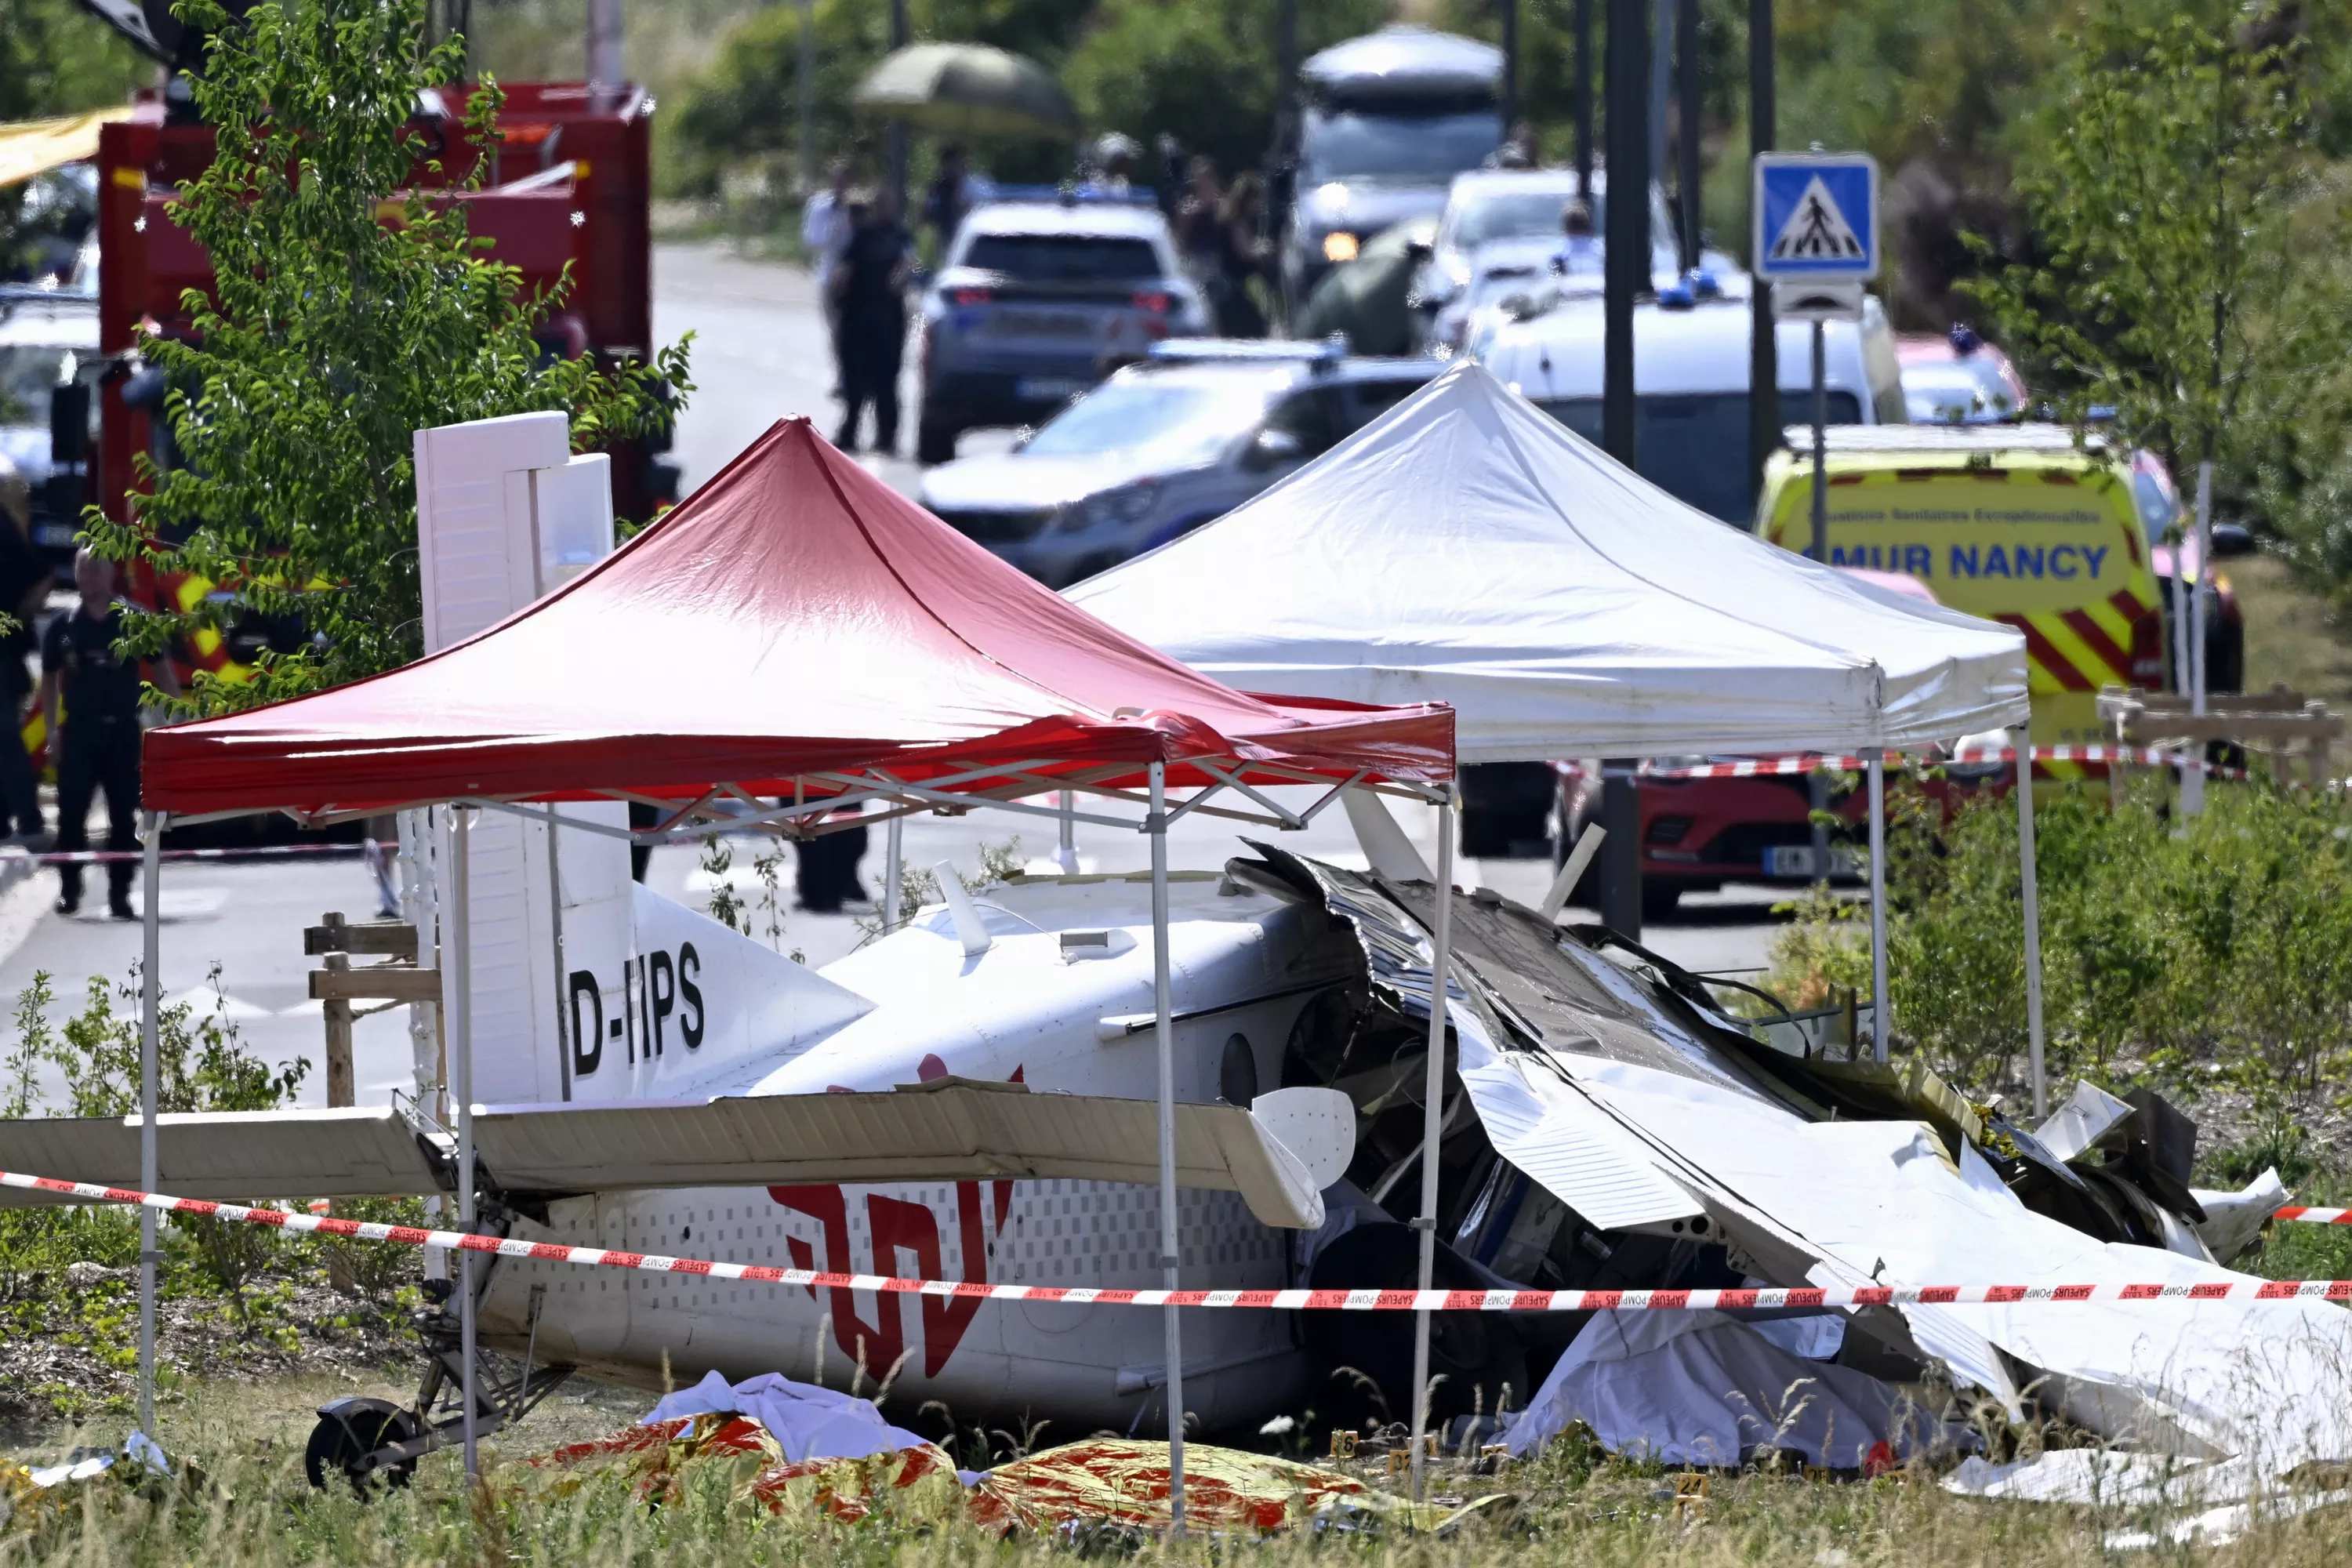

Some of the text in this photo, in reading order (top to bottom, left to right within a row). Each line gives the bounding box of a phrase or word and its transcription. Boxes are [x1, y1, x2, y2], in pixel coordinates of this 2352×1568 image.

[1951, 543, 2108, 581] NANCY
[2011, 1287, 2090, 1299] SAPEURS-POMPIERS
[2147, 1286, 2227, 1296] SAPEURS-POMPIERS
